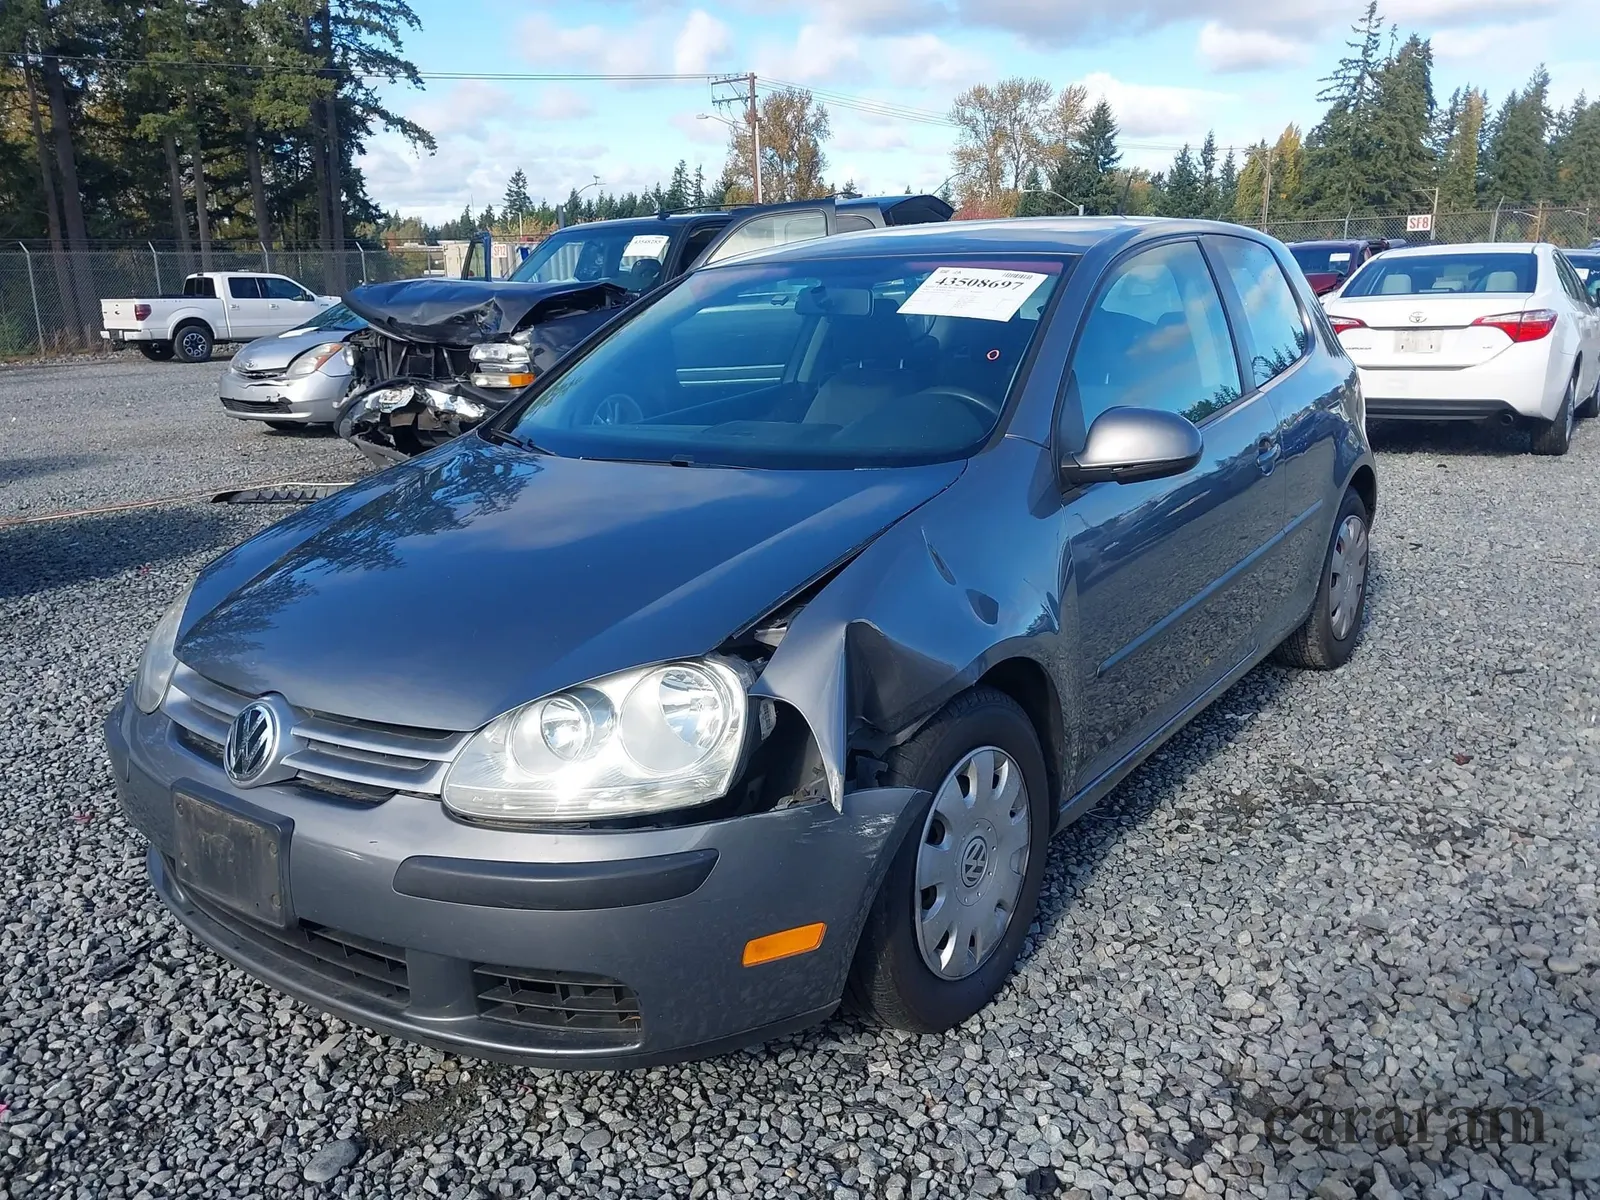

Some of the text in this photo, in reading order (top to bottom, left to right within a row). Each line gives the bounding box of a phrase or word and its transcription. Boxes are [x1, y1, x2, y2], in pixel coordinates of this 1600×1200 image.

[1409, 216, 1429, 229] SF8
[493, 245, 506, 256] SF12
[935, 276, 1025, 291] 43508697
[225, 702, 279, 786] VW
